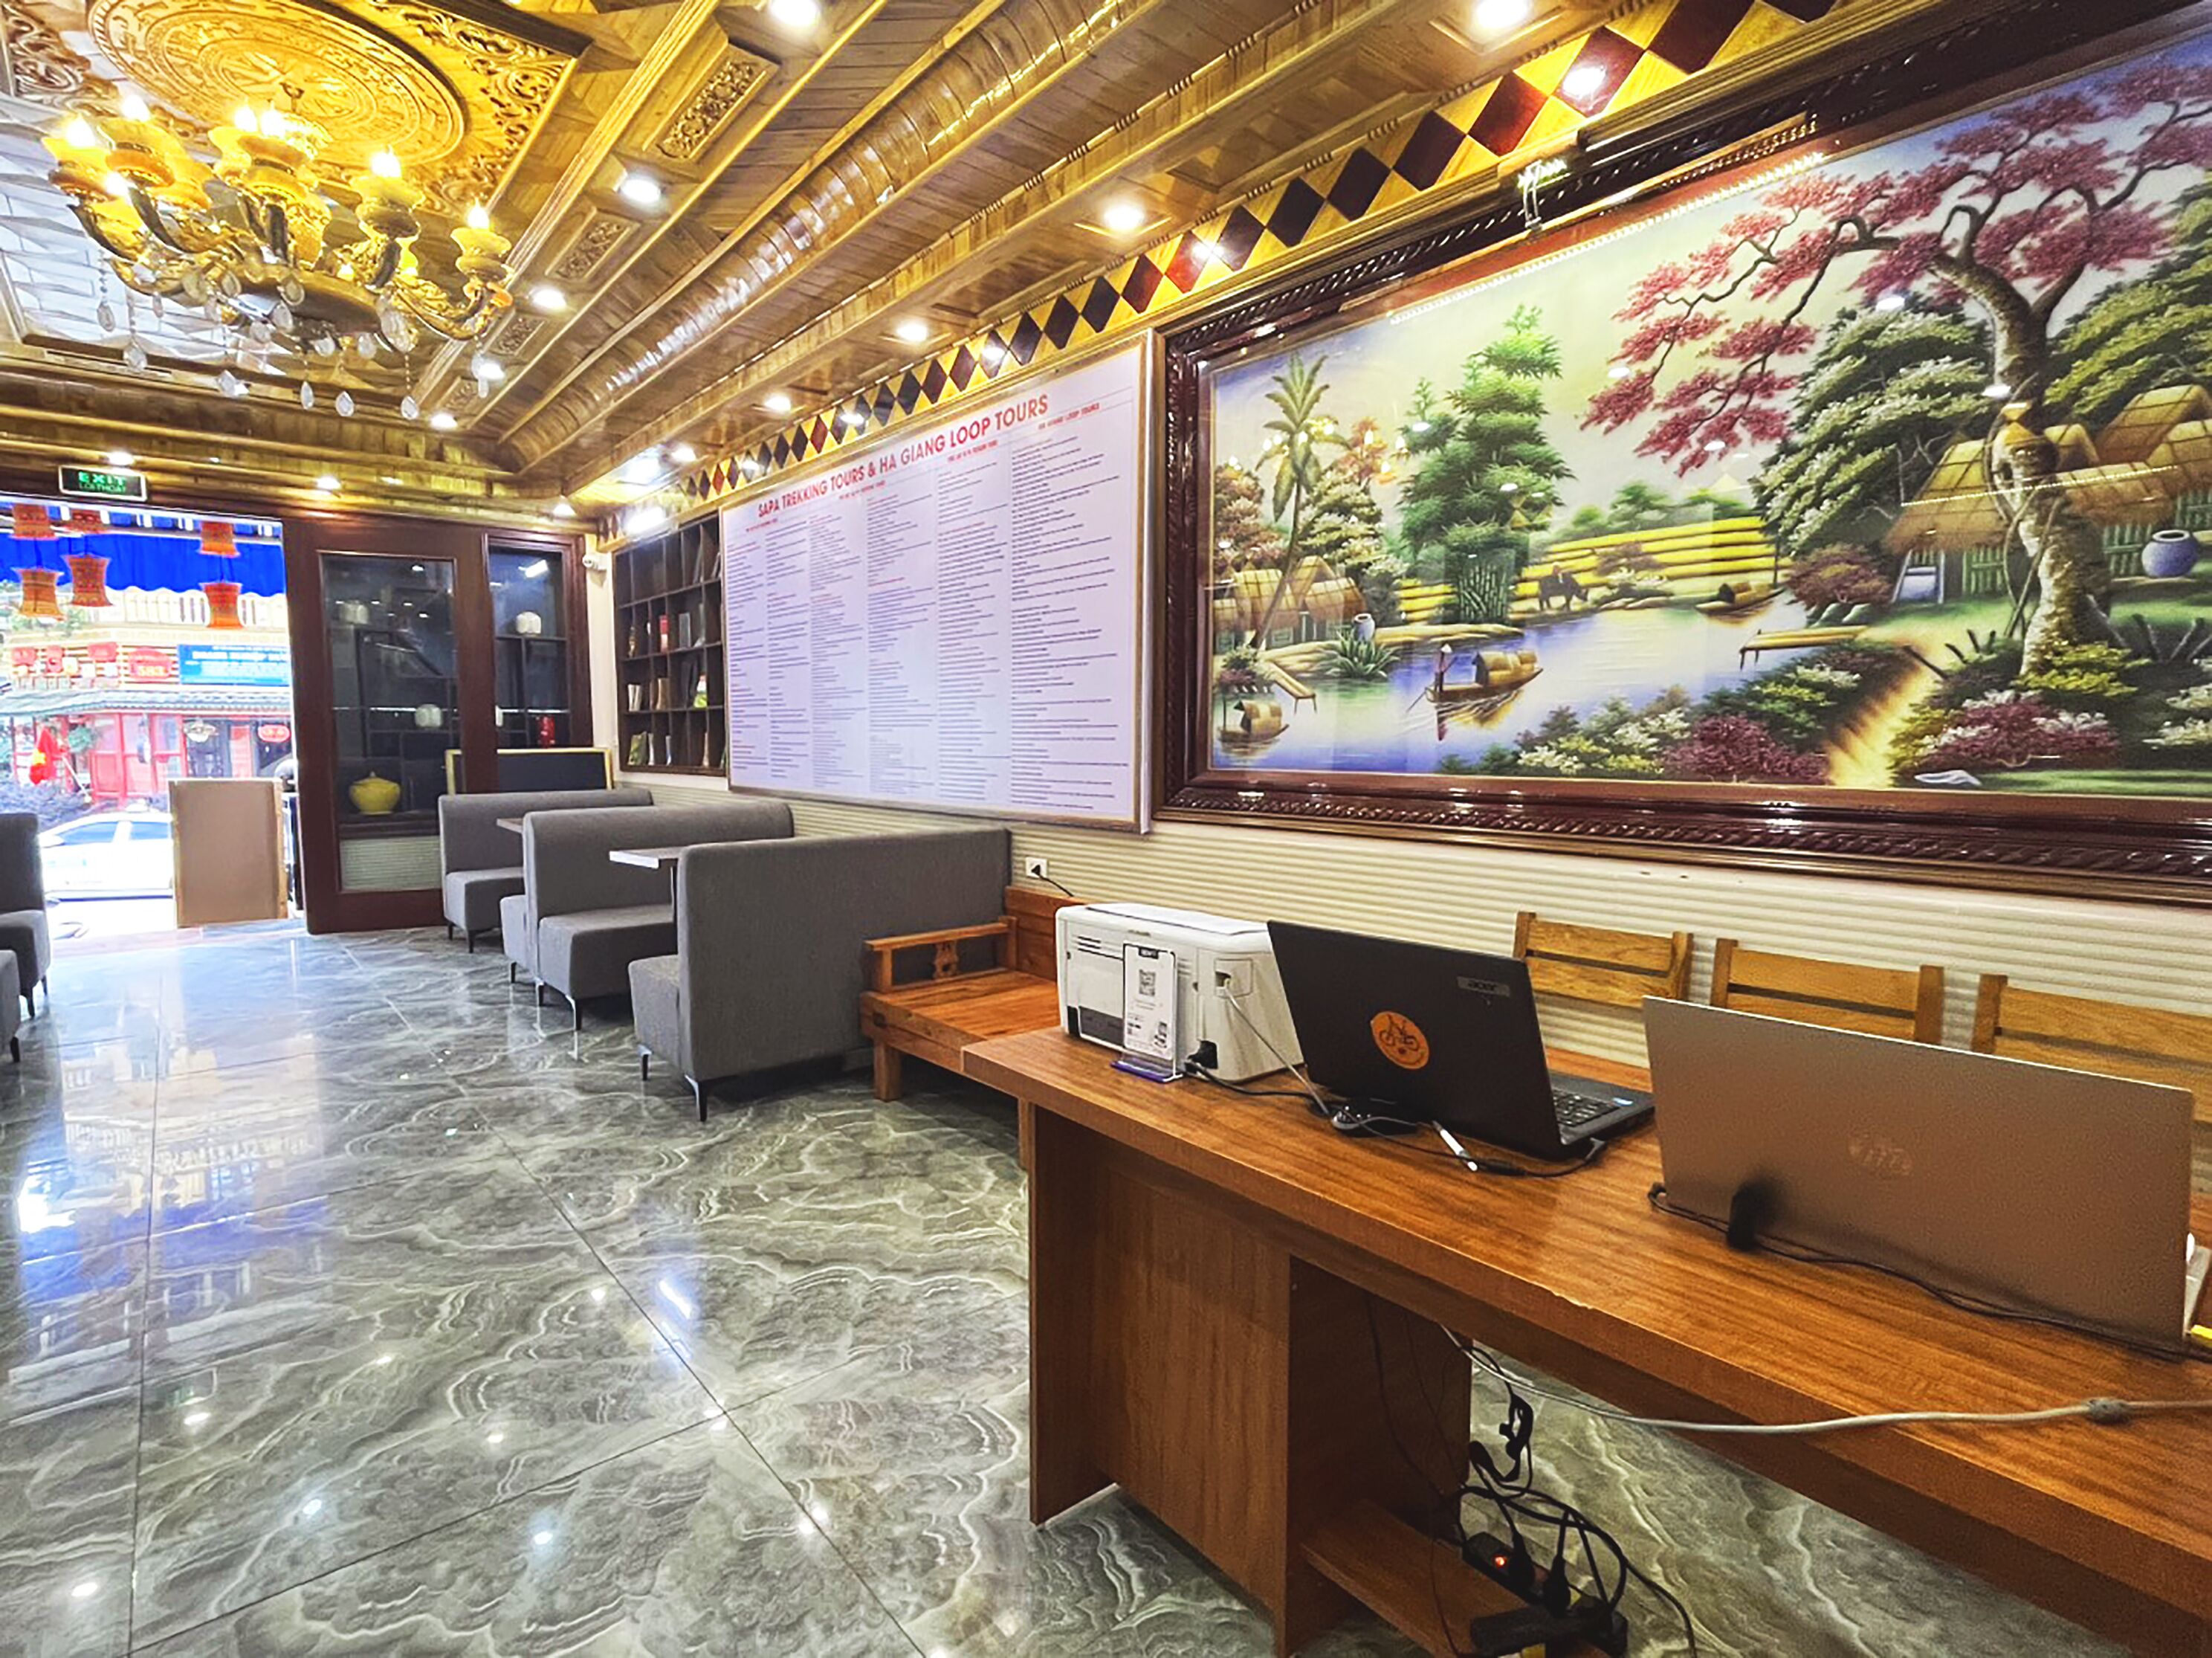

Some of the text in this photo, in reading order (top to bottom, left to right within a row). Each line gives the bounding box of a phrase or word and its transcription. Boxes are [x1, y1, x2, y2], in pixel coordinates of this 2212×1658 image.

[78, 471, 126, 486] EXIT
[758, 499, 780, 517] SAPA
[782, 480, 828, 509] TREKKING
[830, 465, 865, 491] TOURS
[868, 462, 876, 477] &
[879, 453, 897, 474] HA
[900, 434, 945, 465] GIANG
[950, 417, 991, 448] LOOP
[995, 394, 1048, 430] TOURS
